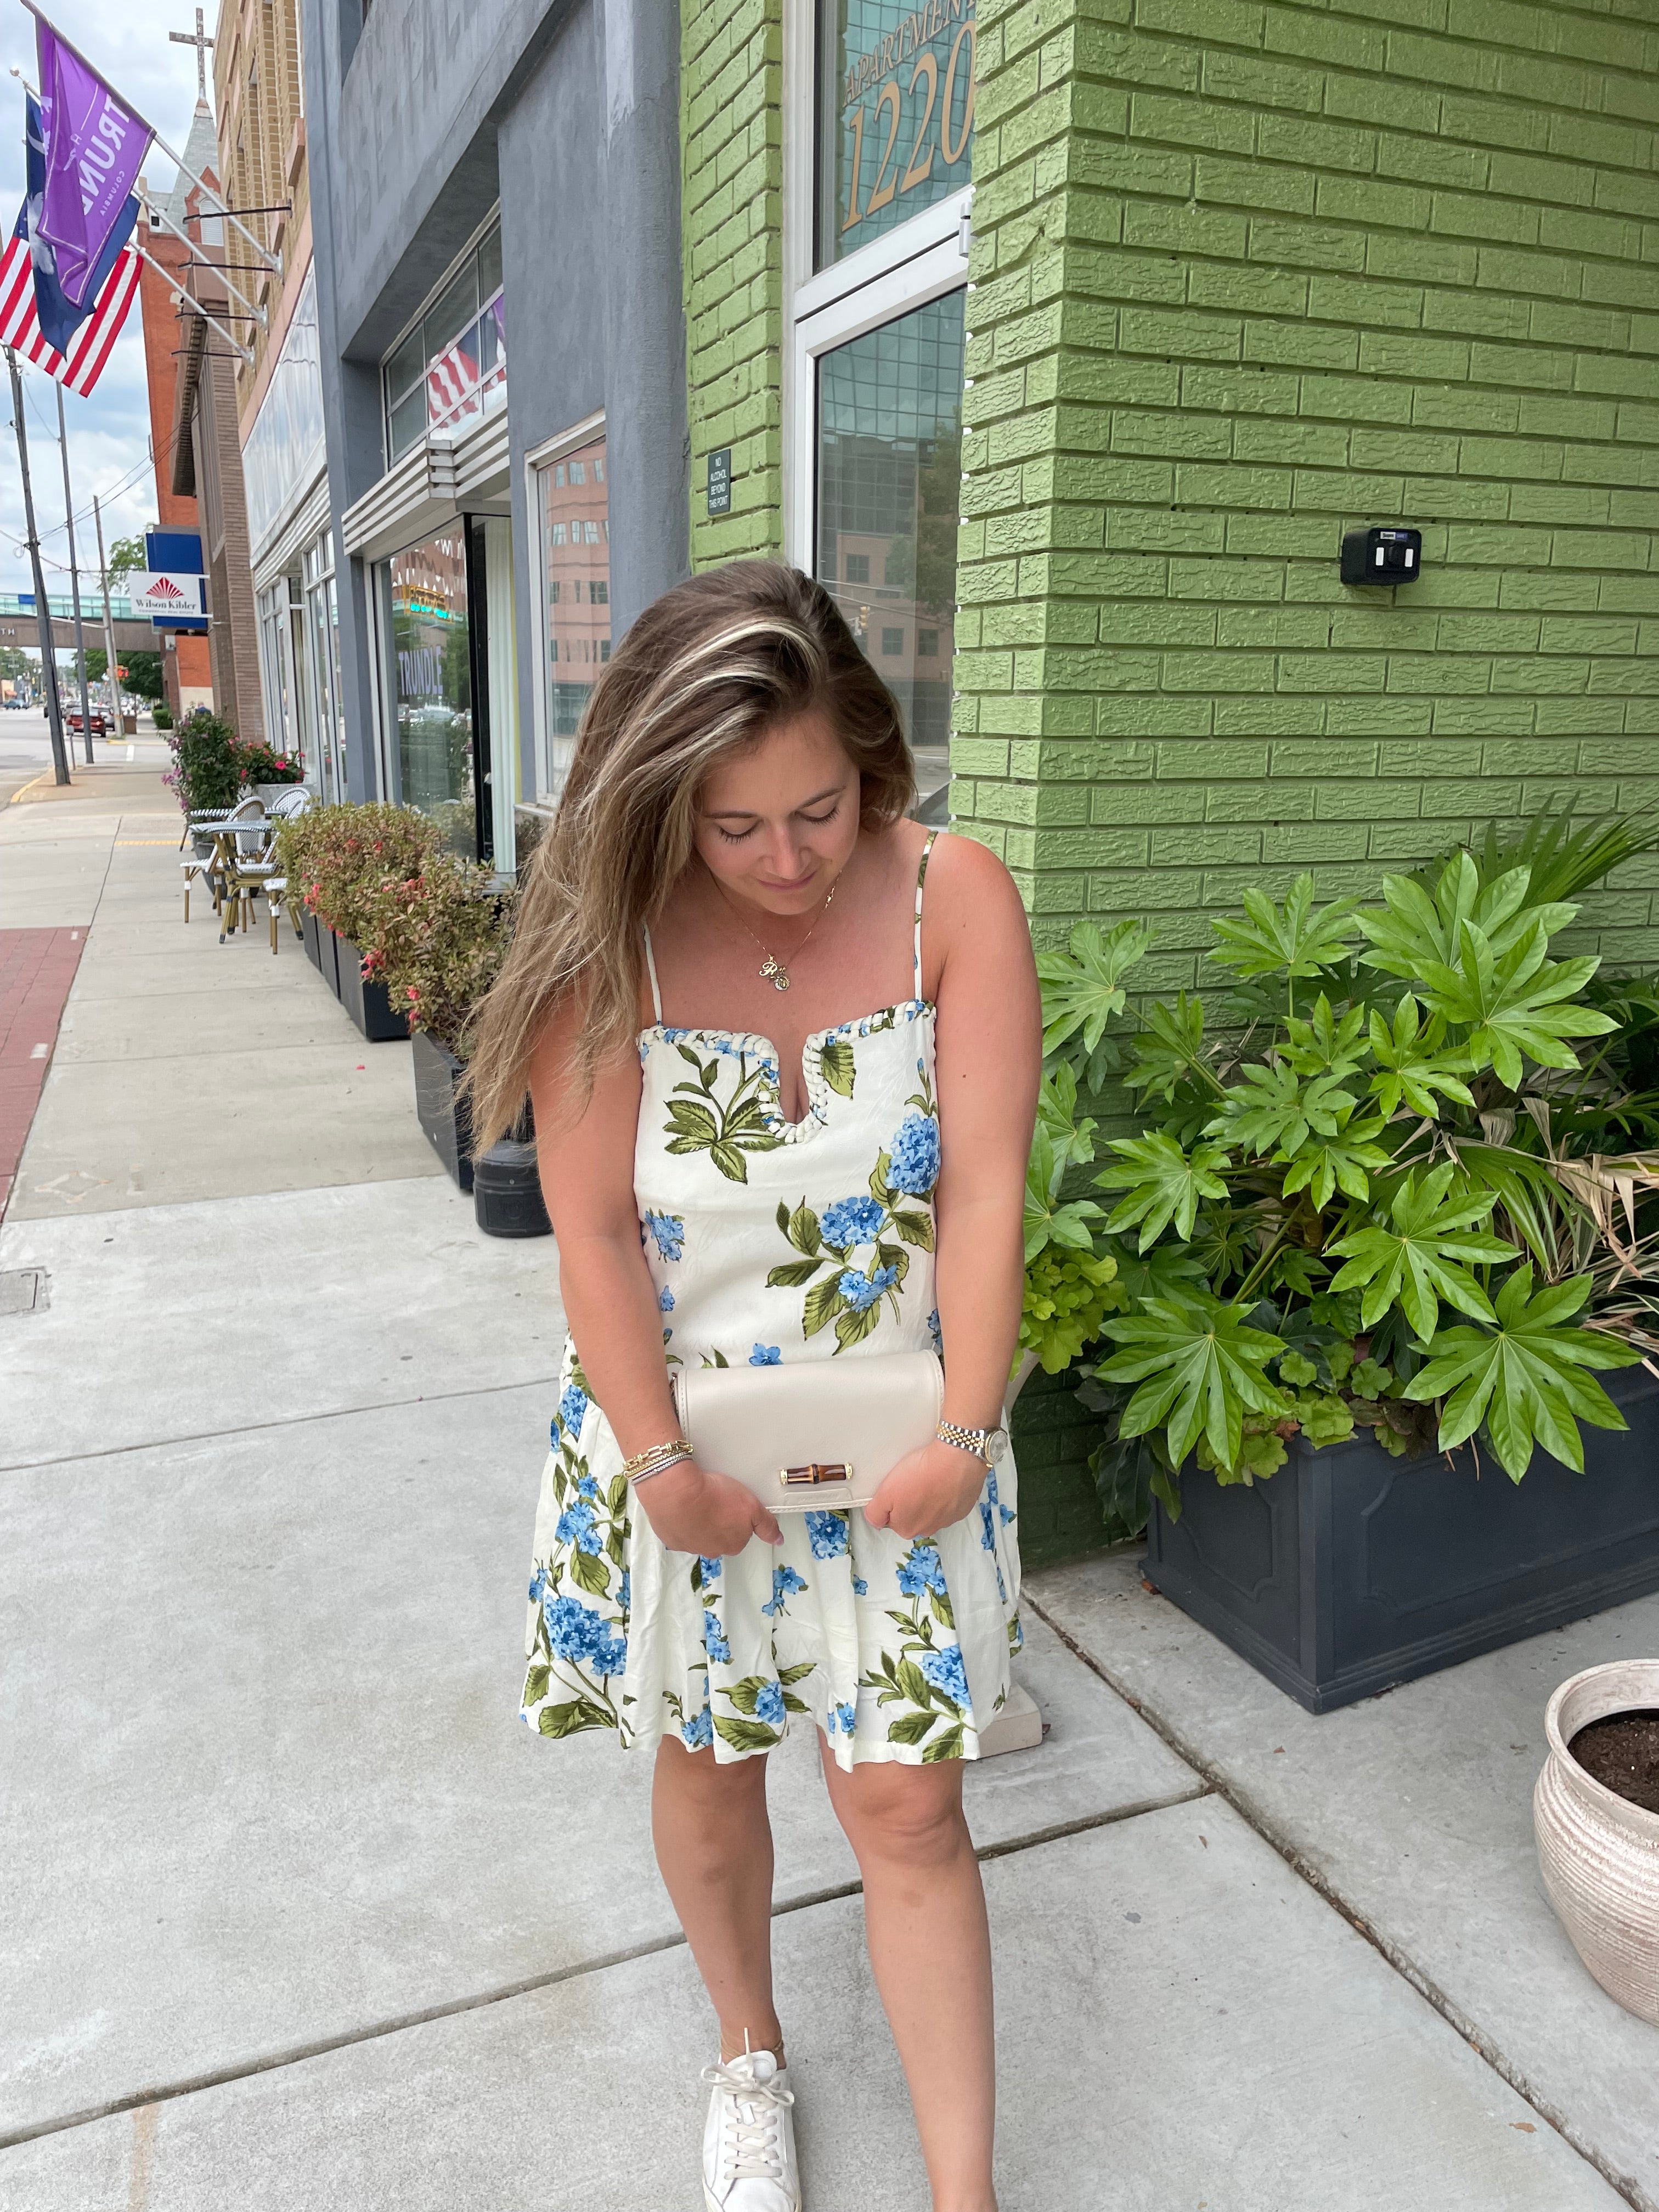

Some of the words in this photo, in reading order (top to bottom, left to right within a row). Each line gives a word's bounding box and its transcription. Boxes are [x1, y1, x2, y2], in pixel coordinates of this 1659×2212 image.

[843, 0, 975, 108] APARTMEN
[842, 20, 977, 233] 1220
[715, 456, 722, 467] NO
[710, 469, 727, 482] ALCOHOL
[710, 482, 726, 495] BEYOND
[709, 498, 717, 509] THIS
[717, 495, 728, 506] POINT
[136, 599, 167, 608] Wilson
[168, 600, 196, 610] Kibler
[399, 646, 443, 696] TRUNDLE
